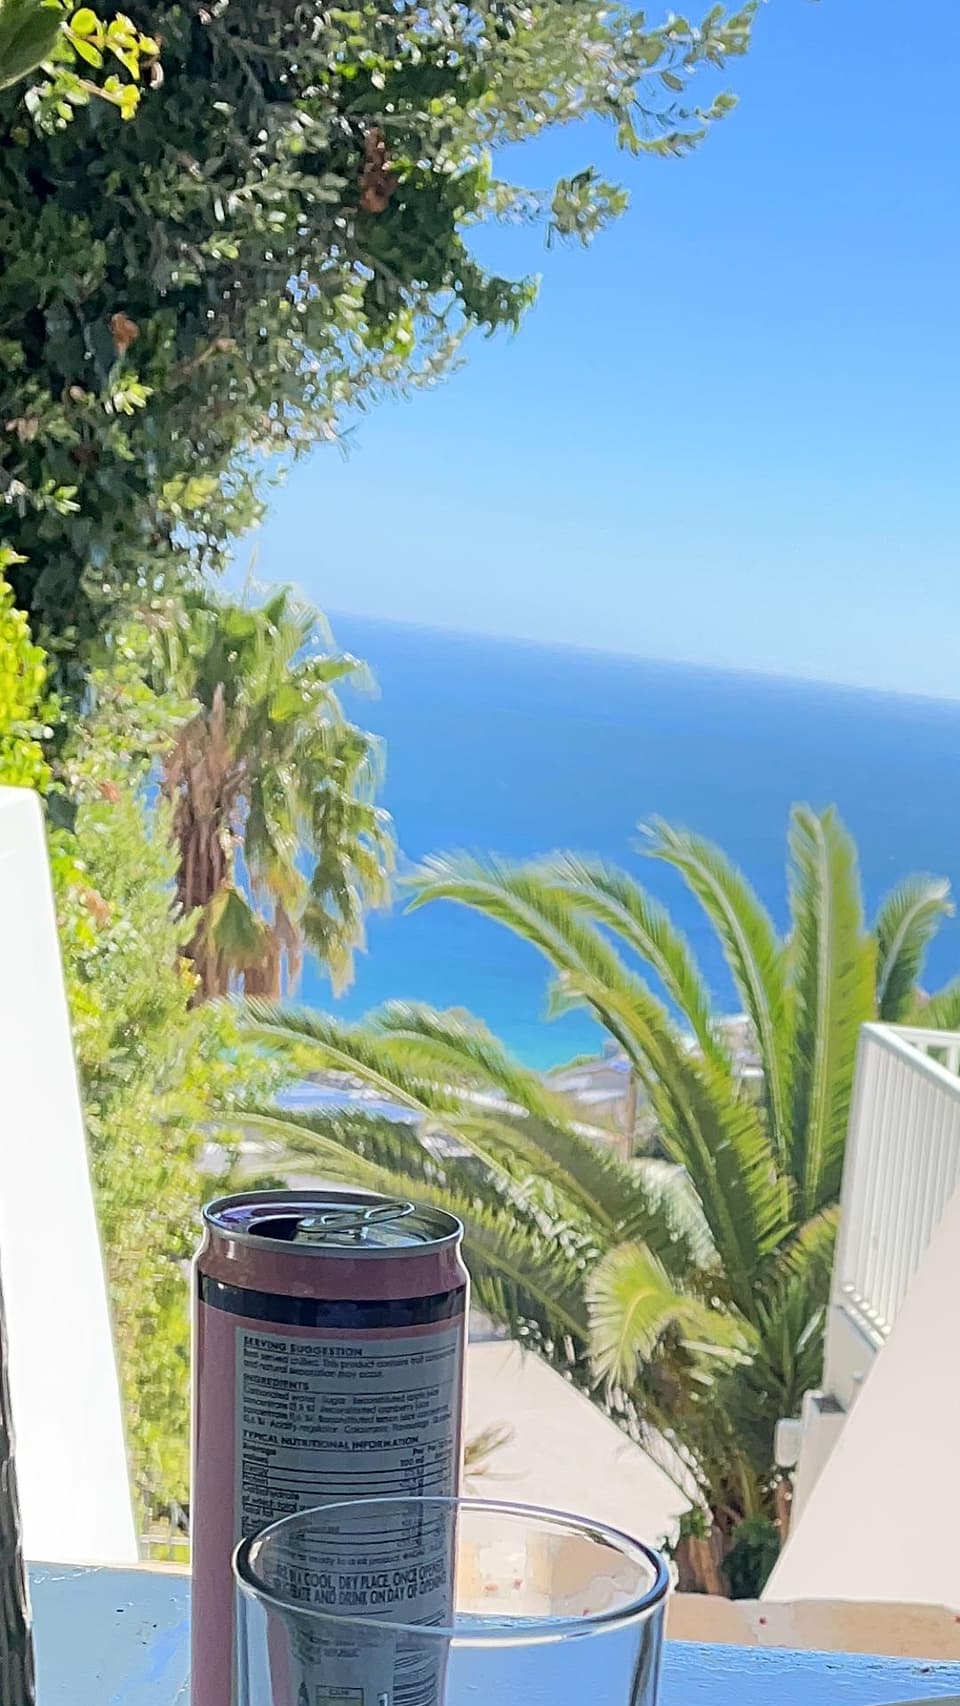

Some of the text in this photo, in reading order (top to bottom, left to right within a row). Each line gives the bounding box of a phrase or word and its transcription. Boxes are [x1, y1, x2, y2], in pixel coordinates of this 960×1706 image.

[243, 1336, 363, 1356] SERVING SUGGESTION
[243, 1373, 310, 1391] INGREDIENTS
[242, 1429, 419, 1451] TYPICAL NUTRITIONAL INFORMATION
[339, 1575, 359, 1590] DRY
[393, 1567, 418, 1587] ONCE
[315, 1589, 336, 1604] AND
[339, 1591, 368, 1606] DRINK
[370, 1590, 386, 1605] ON
[387, 1586, 405, 1603] DAY
[407, 1583, 418, 1599] OF
